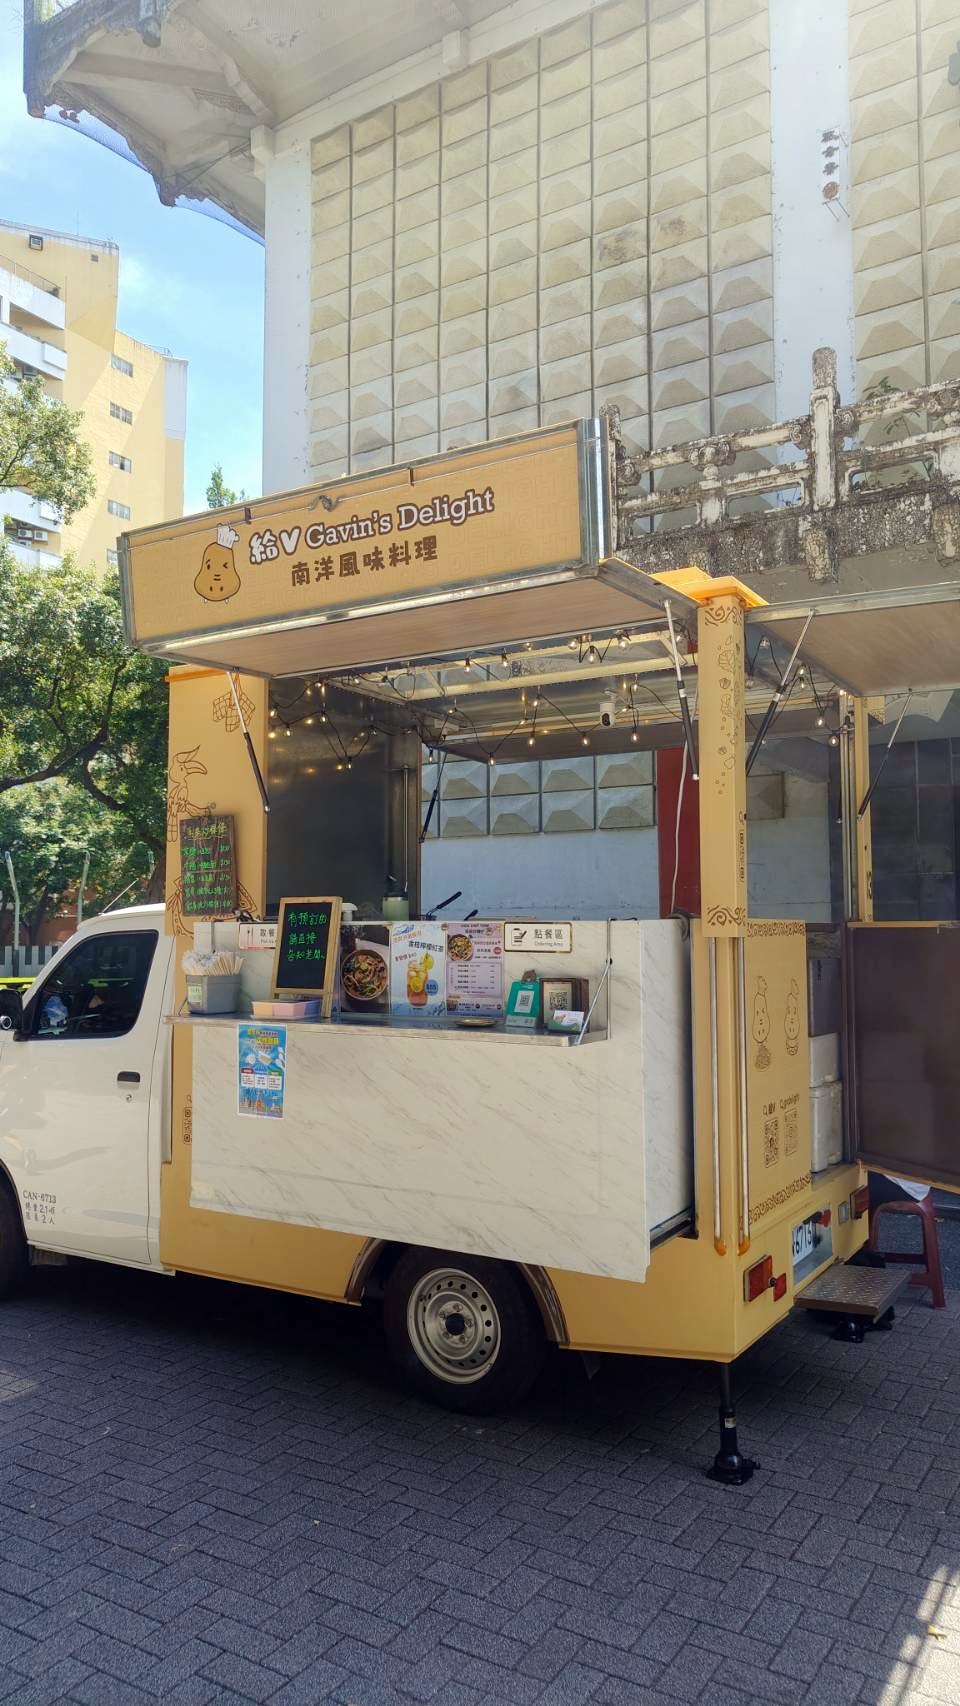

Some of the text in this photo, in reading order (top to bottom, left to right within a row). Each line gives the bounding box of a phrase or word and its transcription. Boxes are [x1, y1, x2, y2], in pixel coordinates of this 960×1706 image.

[305, 487, 494, 549] Gavin's Delight
[291, 536, 438, 587] 南洋風味料理
[534, 929, 563, 939] 點餐區
